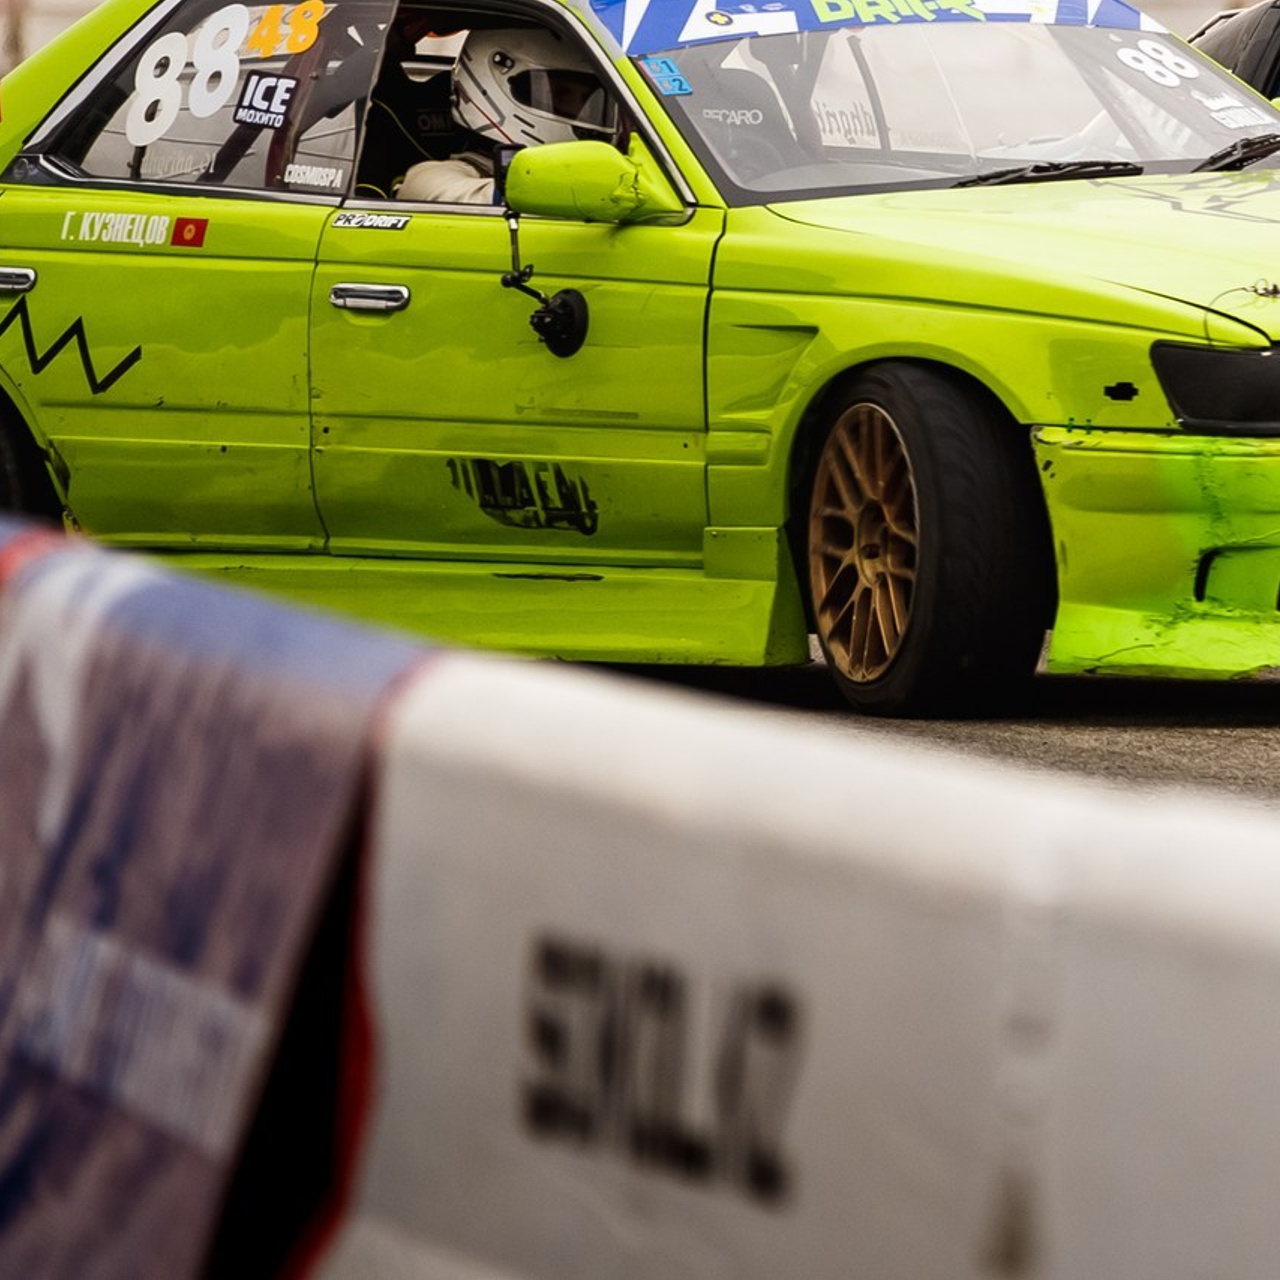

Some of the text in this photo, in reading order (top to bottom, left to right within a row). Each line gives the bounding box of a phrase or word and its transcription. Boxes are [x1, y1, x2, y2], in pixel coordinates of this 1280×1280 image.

[126, 3, 250, 147] 88
[1116, 39, 1200, 88] 88
[241, 74, 296, 113] ICE
[60, 211, 171, 248] Г. КУЗНЕЦОВ
